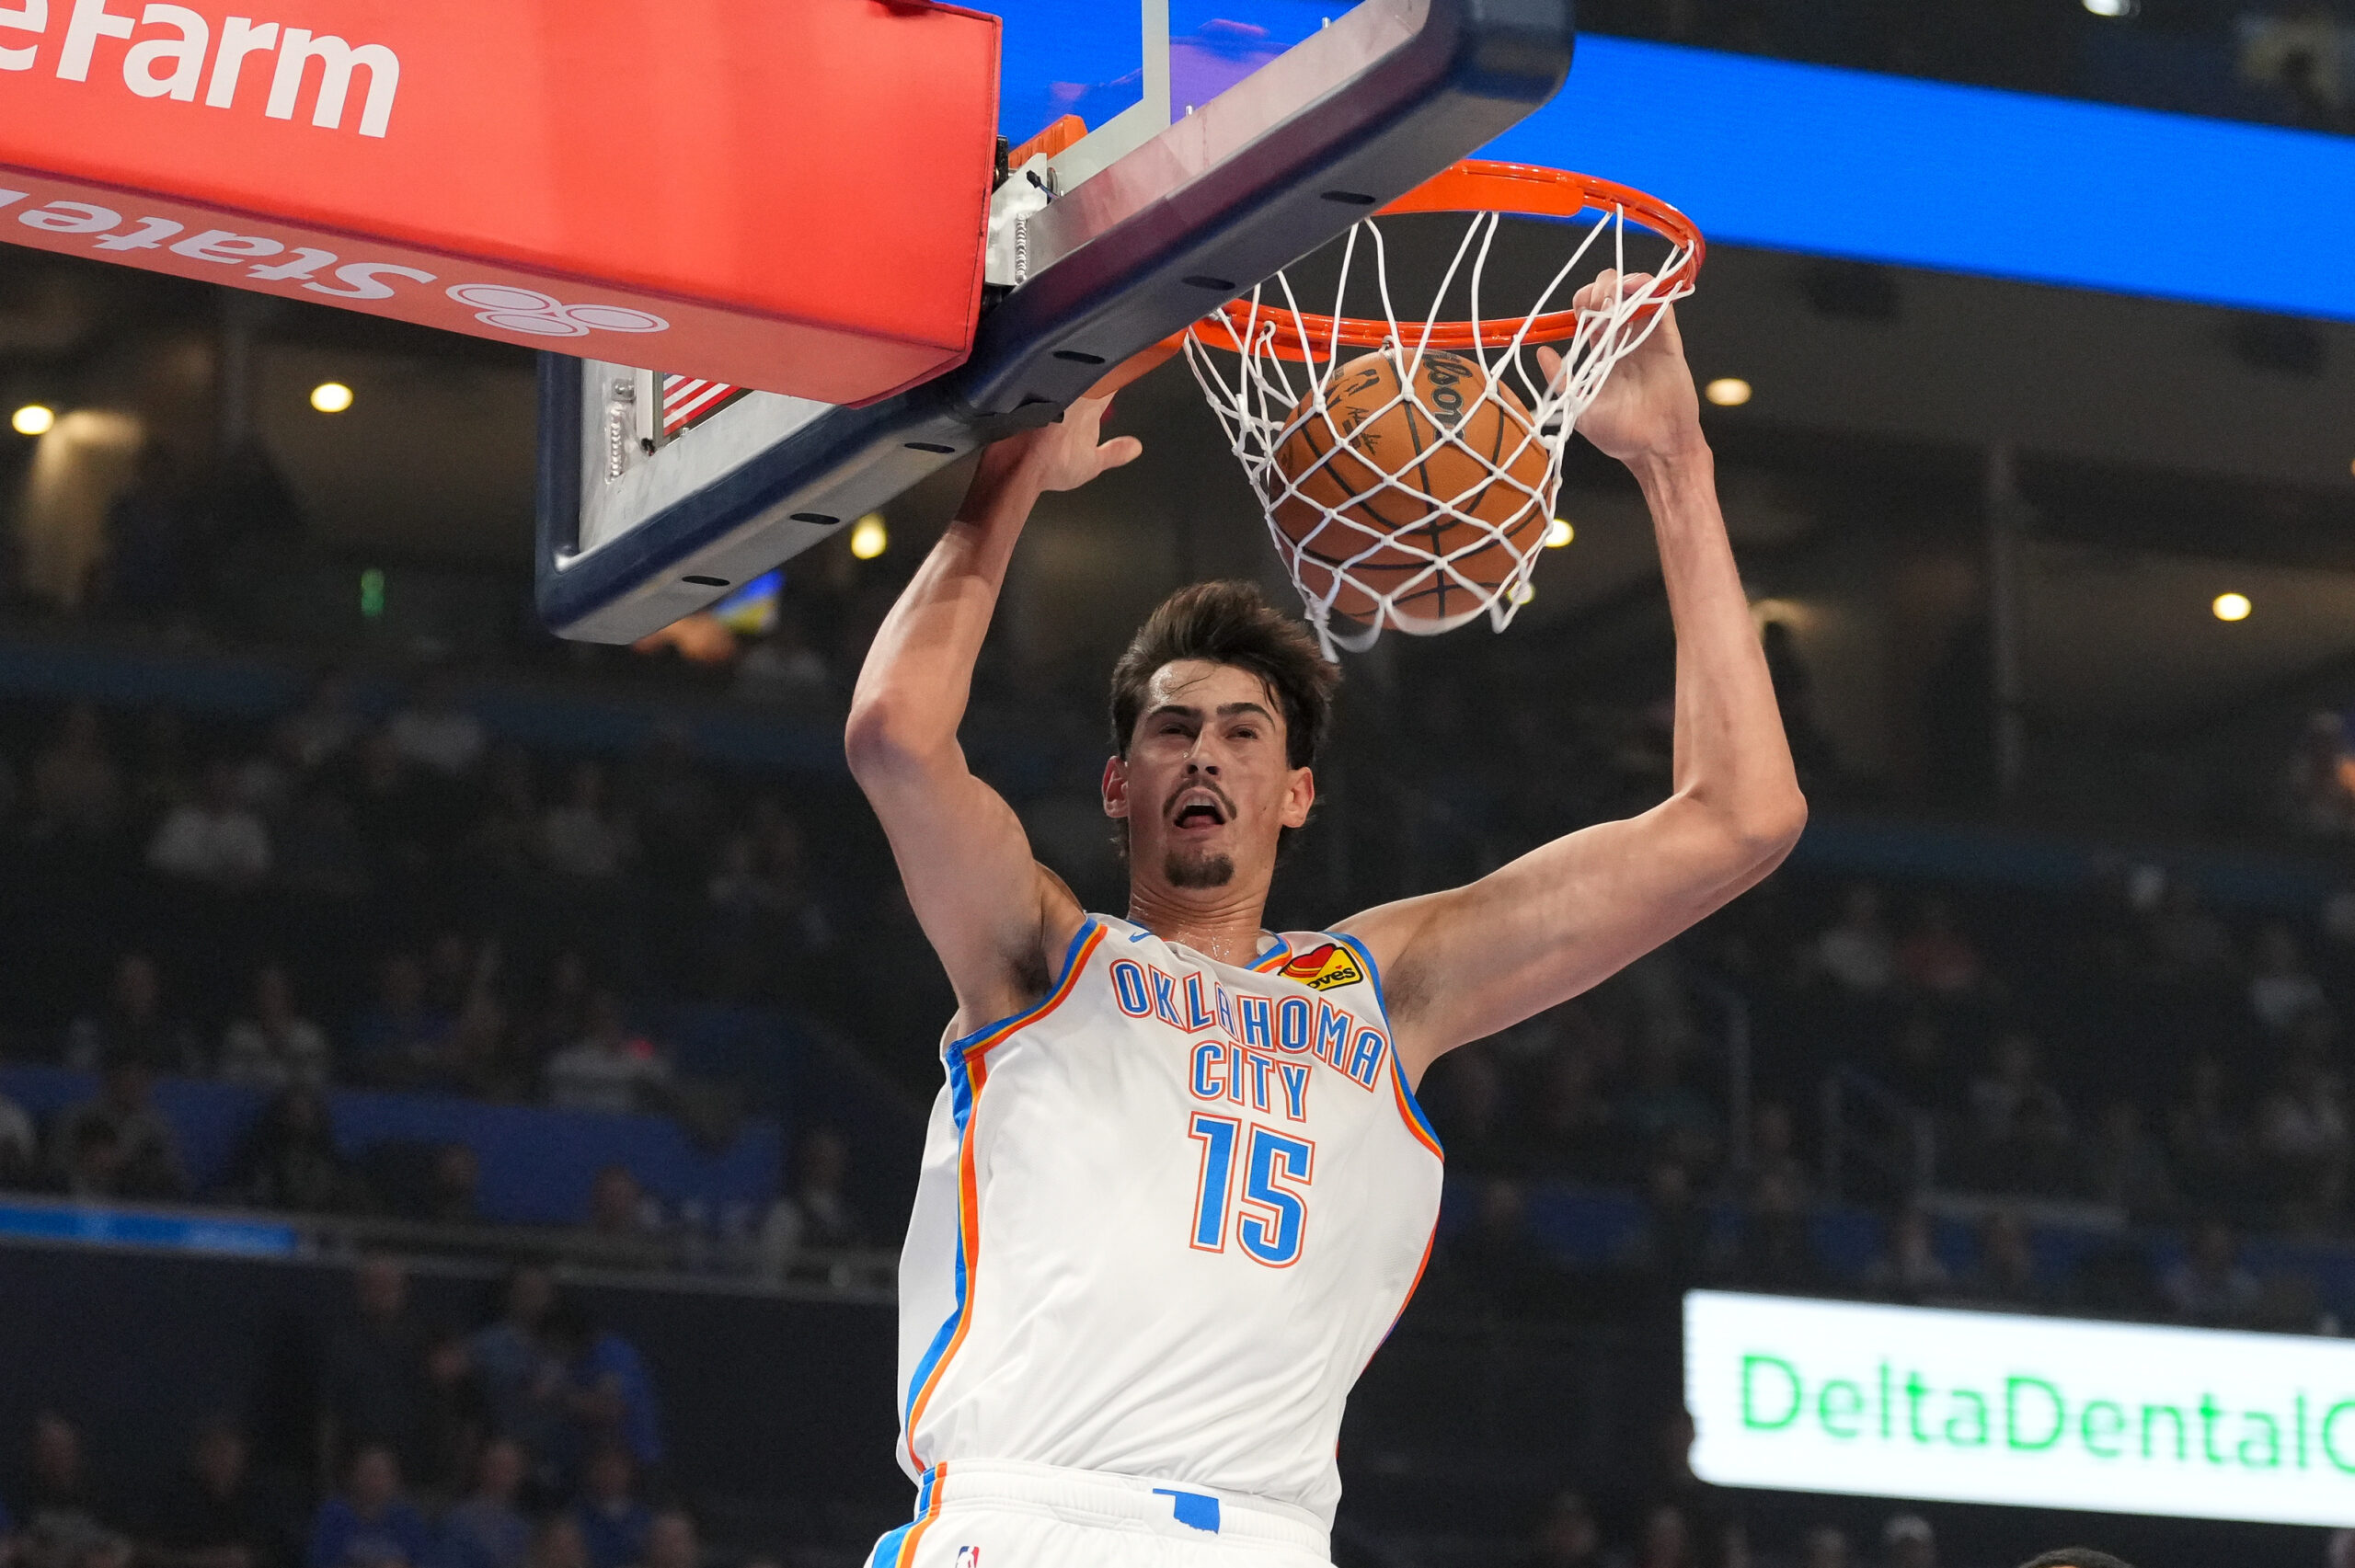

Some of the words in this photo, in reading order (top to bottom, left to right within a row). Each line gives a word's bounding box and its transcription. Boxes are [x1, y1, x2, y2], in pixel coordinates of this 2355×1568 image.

[0, 190, 438, 300] State
[1109, 958, 1389, 1093] OKLAHOMA
[1189, 1040, 1312, 1123] CITY
[1188, 1111, 1315, 1268] 15
